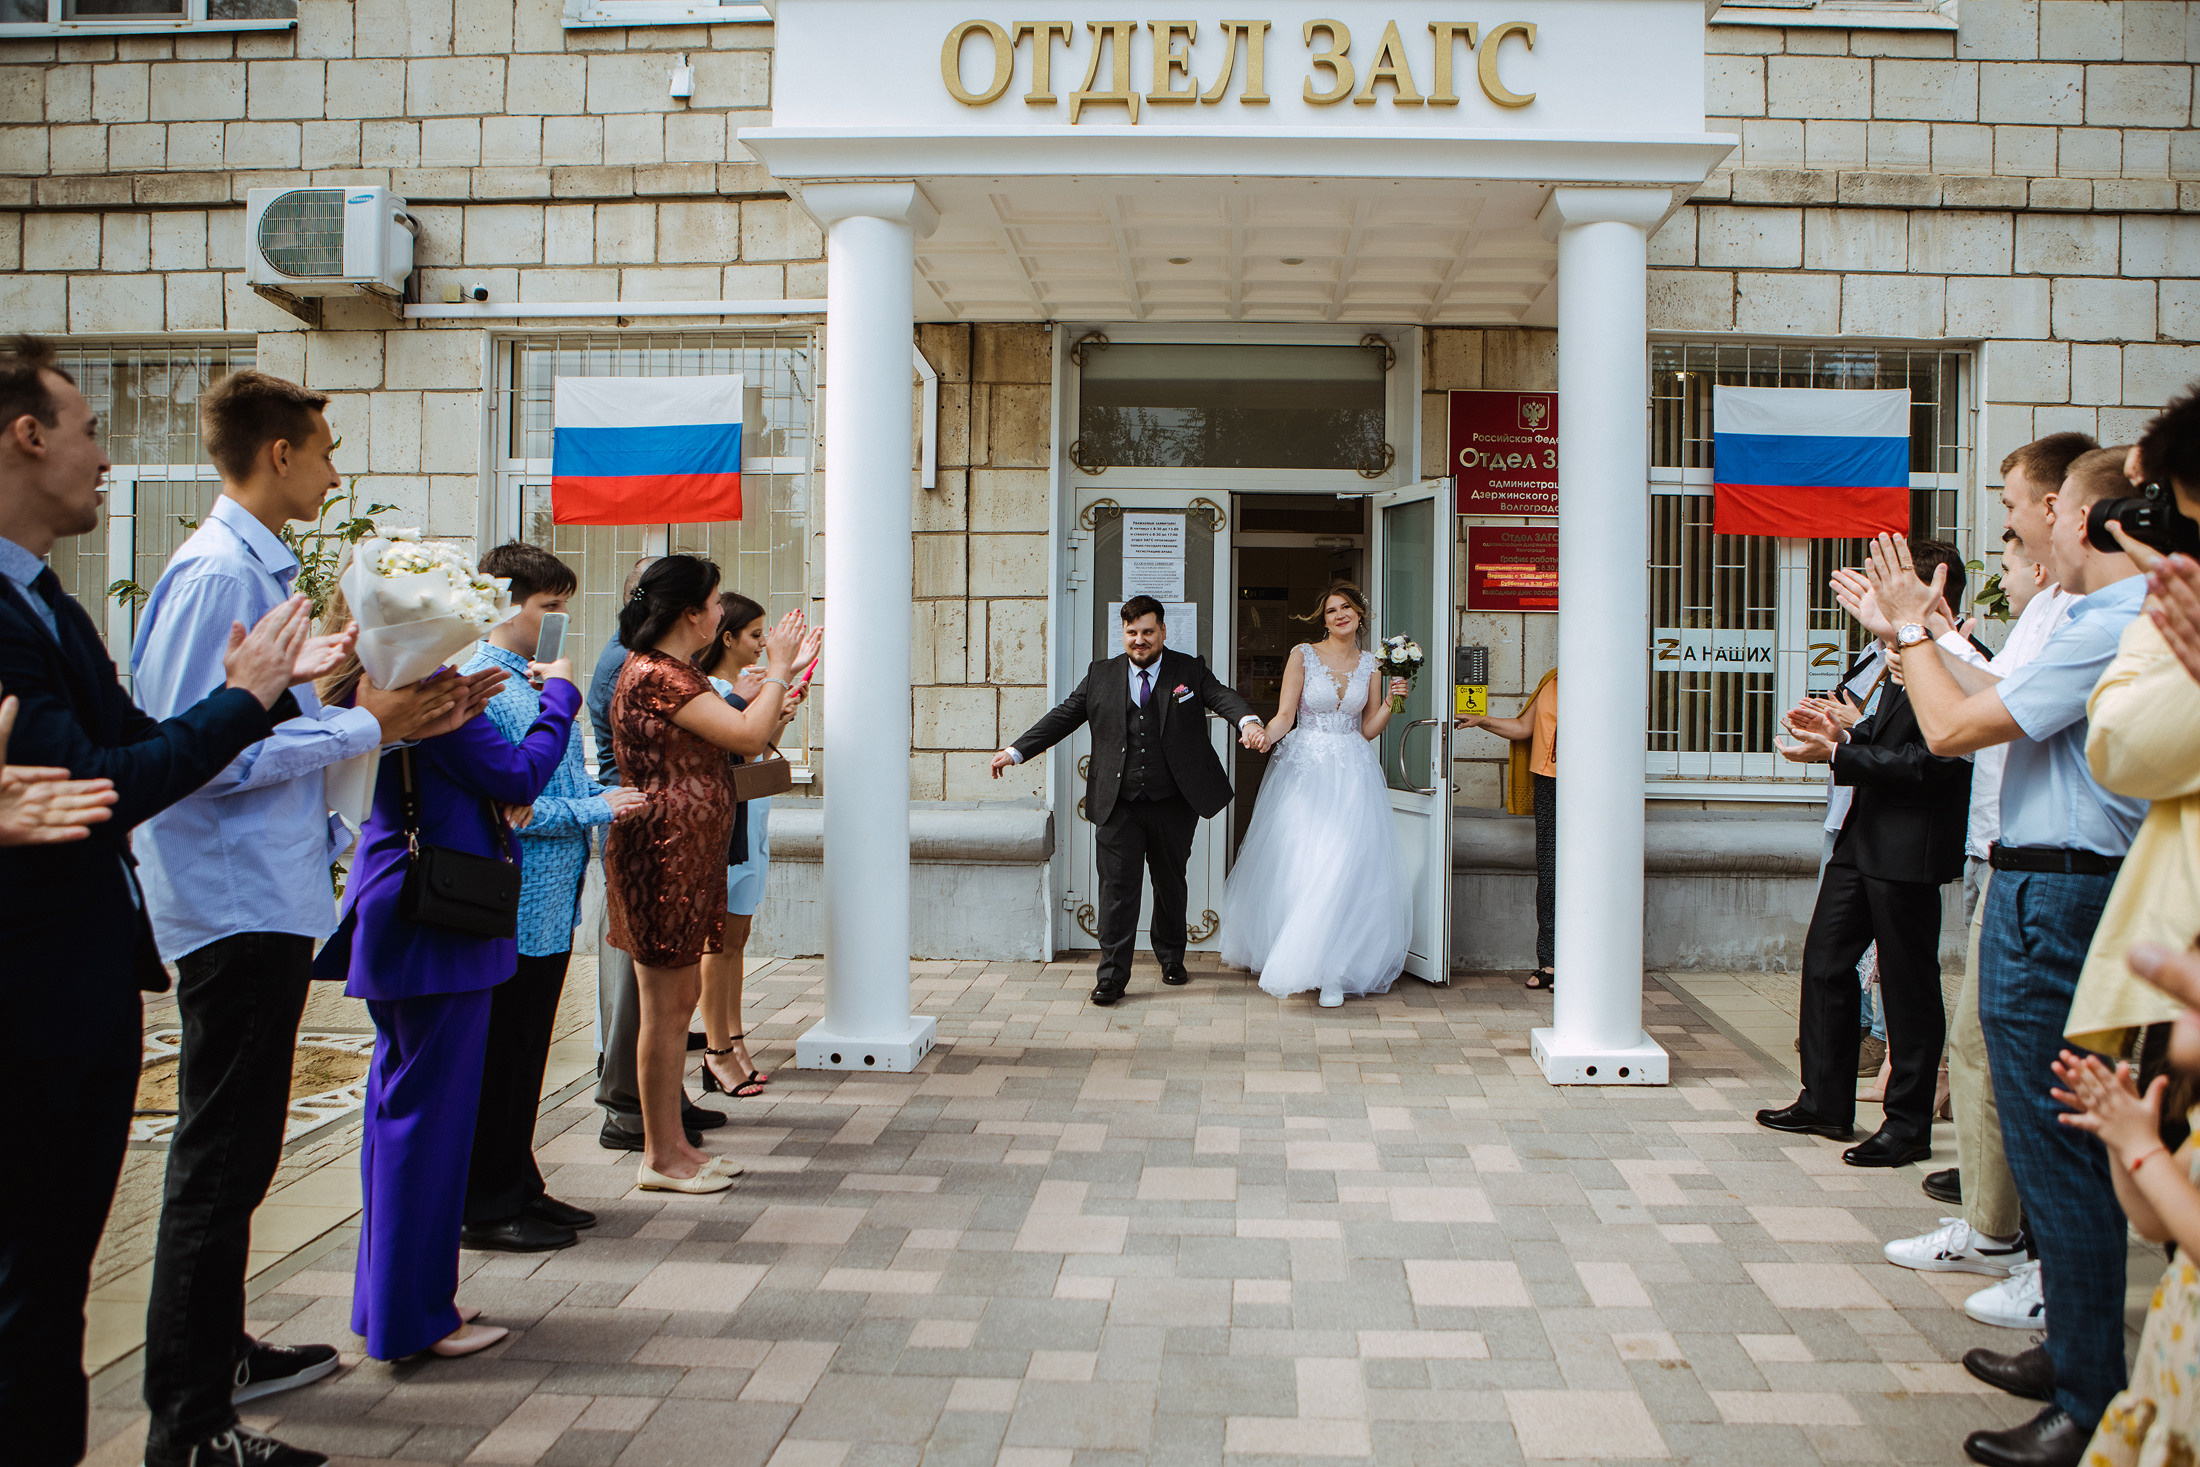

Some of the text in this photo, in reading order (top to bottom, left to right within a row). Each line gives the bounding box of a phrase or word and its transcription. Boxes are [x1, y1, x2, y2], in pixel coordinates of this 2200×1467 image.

[941, 18, 1538, 125] ОТДЕЛ ЗАГС
[1472, 432, 1533, 443] Российская
[1459, 447, 1559, 471] Отдел З
[1470, 489, 1549, 500] Дзержинского
[1501, 532, 1532, 542] Отдел
[1500, 556, 1528, 564] График
[1702, 645, 1772, 662] НАШИХ
